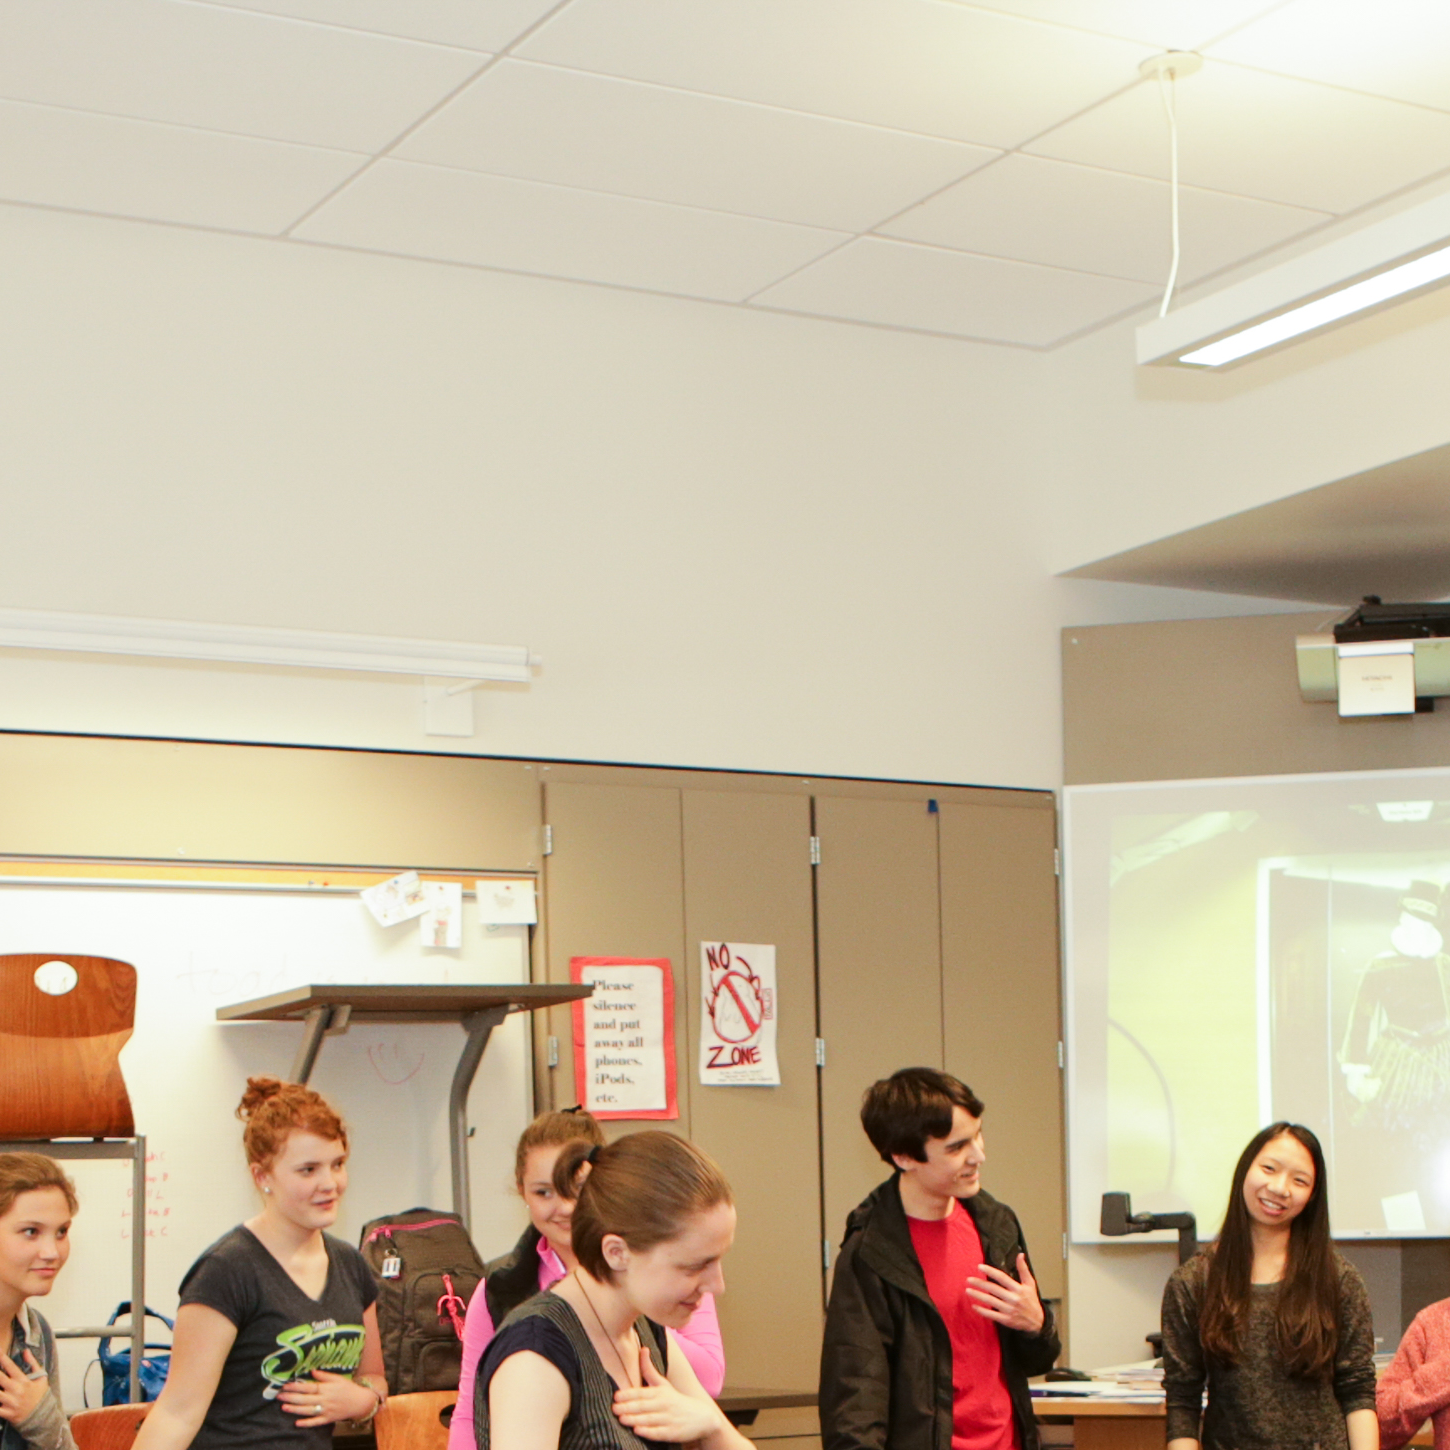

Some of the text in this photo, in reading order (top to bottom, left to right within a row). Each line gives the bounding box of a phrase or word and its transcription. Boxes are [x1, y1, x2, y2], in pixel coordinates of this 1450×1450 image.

[705, 942, 730, 971] NO
[592, 979, 635, 991] Please
[593, 999, 637, 1011] silence
[593, 1018, 641, 1033] and put
[594, 1036, 644, 1051] away all
[705, 1045, 761, 1069] ZONE
[595, 1093, 618, 1103] etc.
